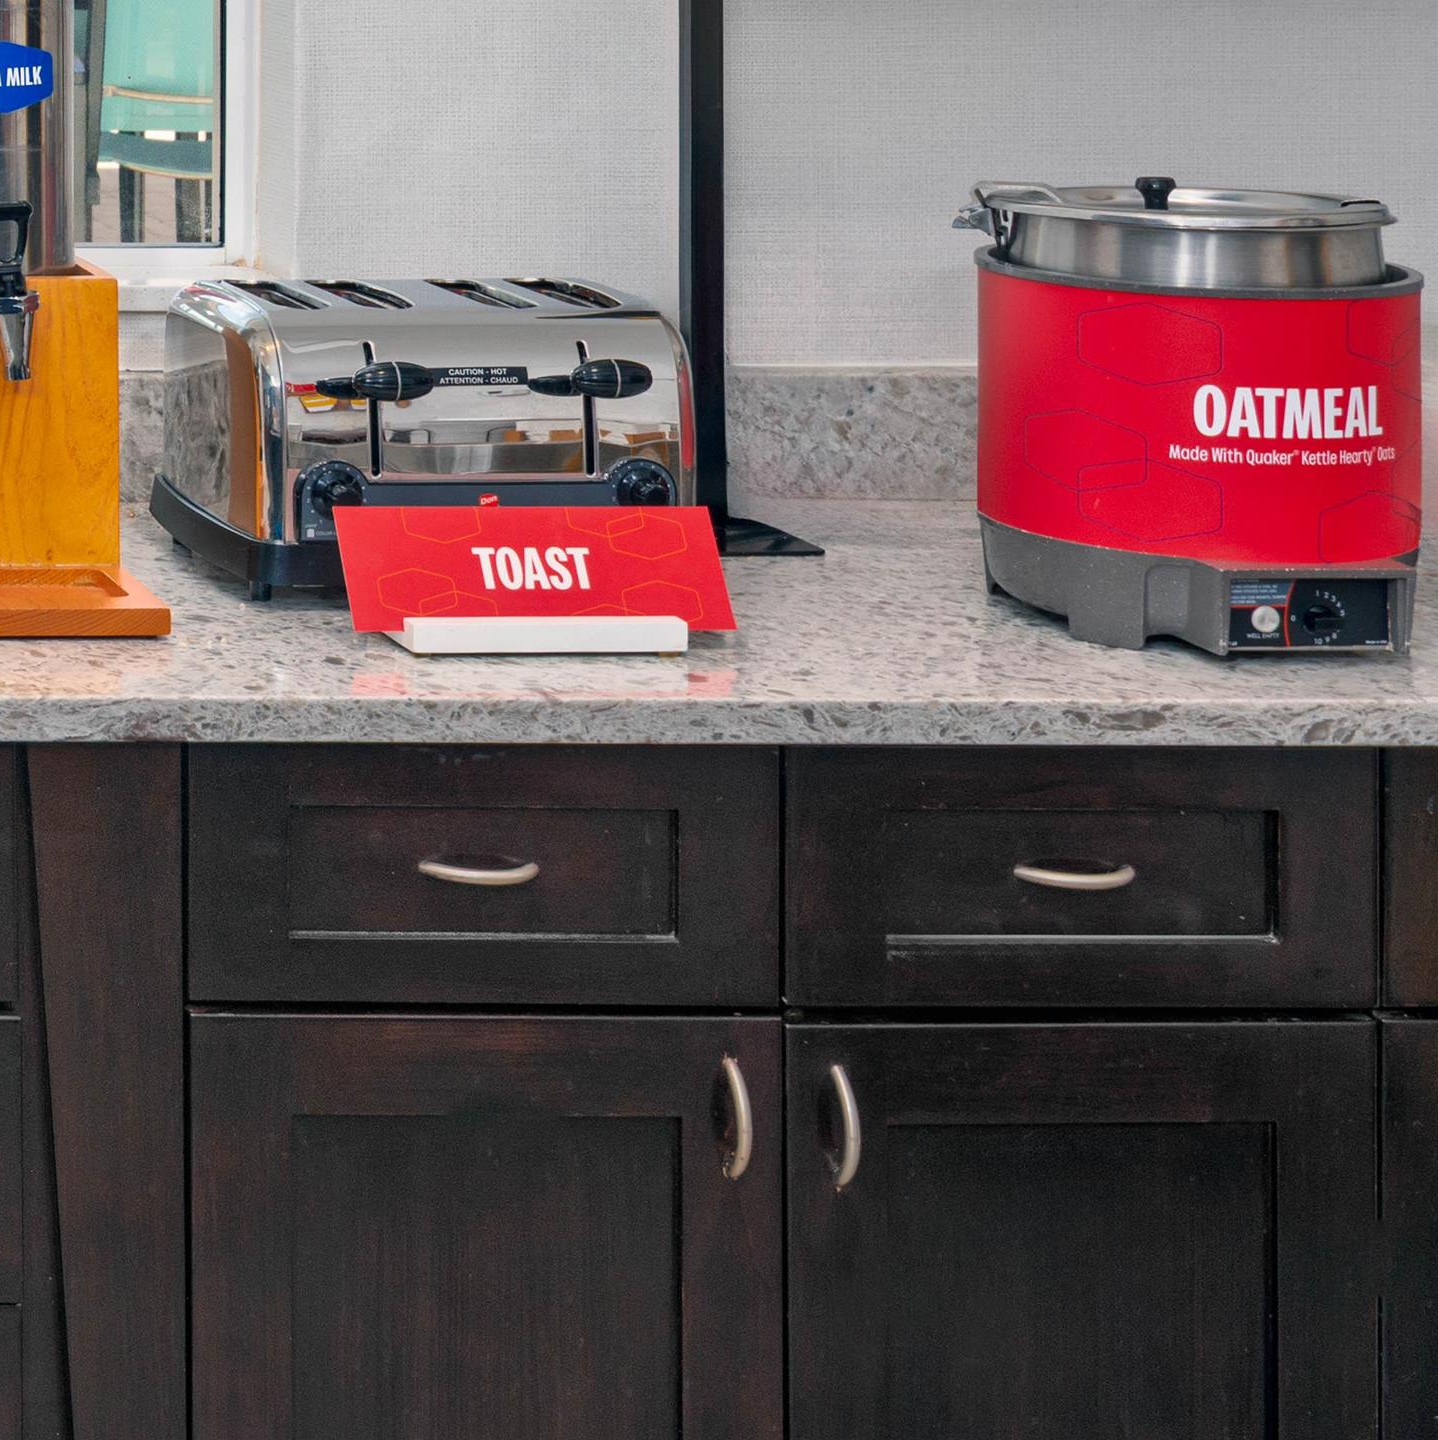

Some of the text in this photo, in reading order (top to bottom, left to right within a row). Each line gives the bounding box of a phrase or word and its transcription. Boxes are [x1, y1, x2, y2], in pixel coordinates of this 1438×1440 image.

[6, 66, 42, 86] MILK
[439, 377, 484, 385] ATTENTION
[448, 368, 484, 376] CAUTION
[490, 368, 508, 376] HOT
[1193, 384, 1383, 439] OATMEAL
[1169, 444, 1208, 461] Made
[1211, 446, 1243, 464] With
[1301, 450, 1337, 466] Kettle
[1377, 446, 1396, 461] Oats
[470, 546, 591, 591] TOAST
